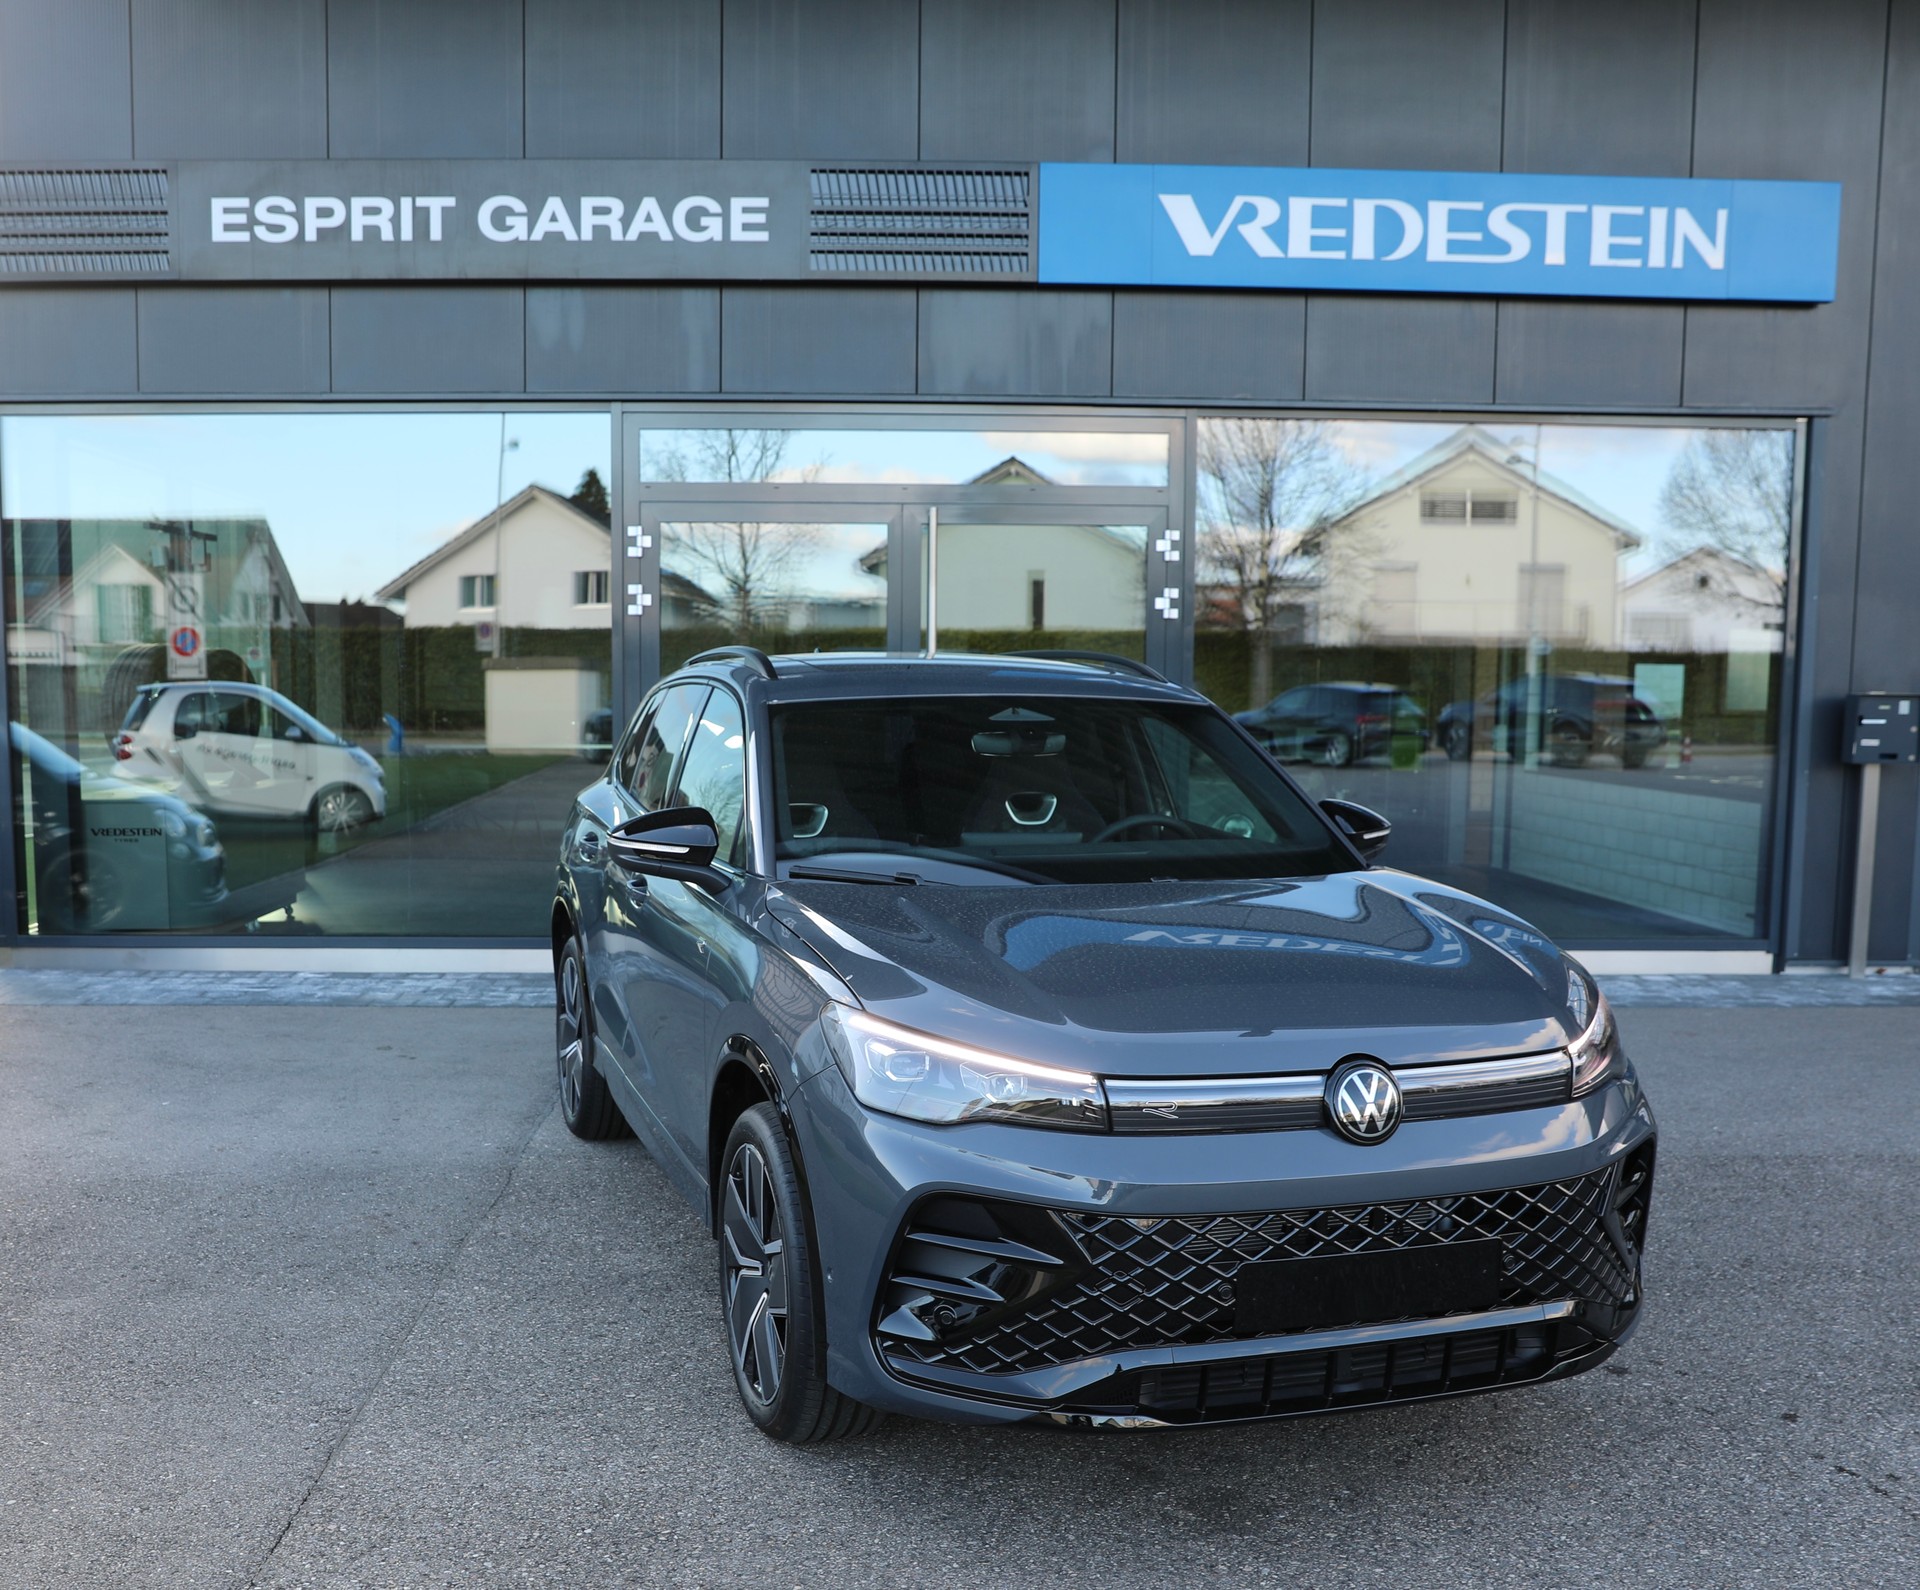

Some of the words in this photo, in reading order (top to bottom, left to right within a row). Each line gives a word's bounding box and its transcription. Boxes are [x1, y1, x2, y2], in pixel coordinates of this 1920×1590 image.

[210, 195, 457, 243] ESPRIT
[477, 195, 770, 243] GARAGE
[1158, 193, 1728, 270] VREDESTEIN
[90, 828, 162, 836] VREDESTEIN
